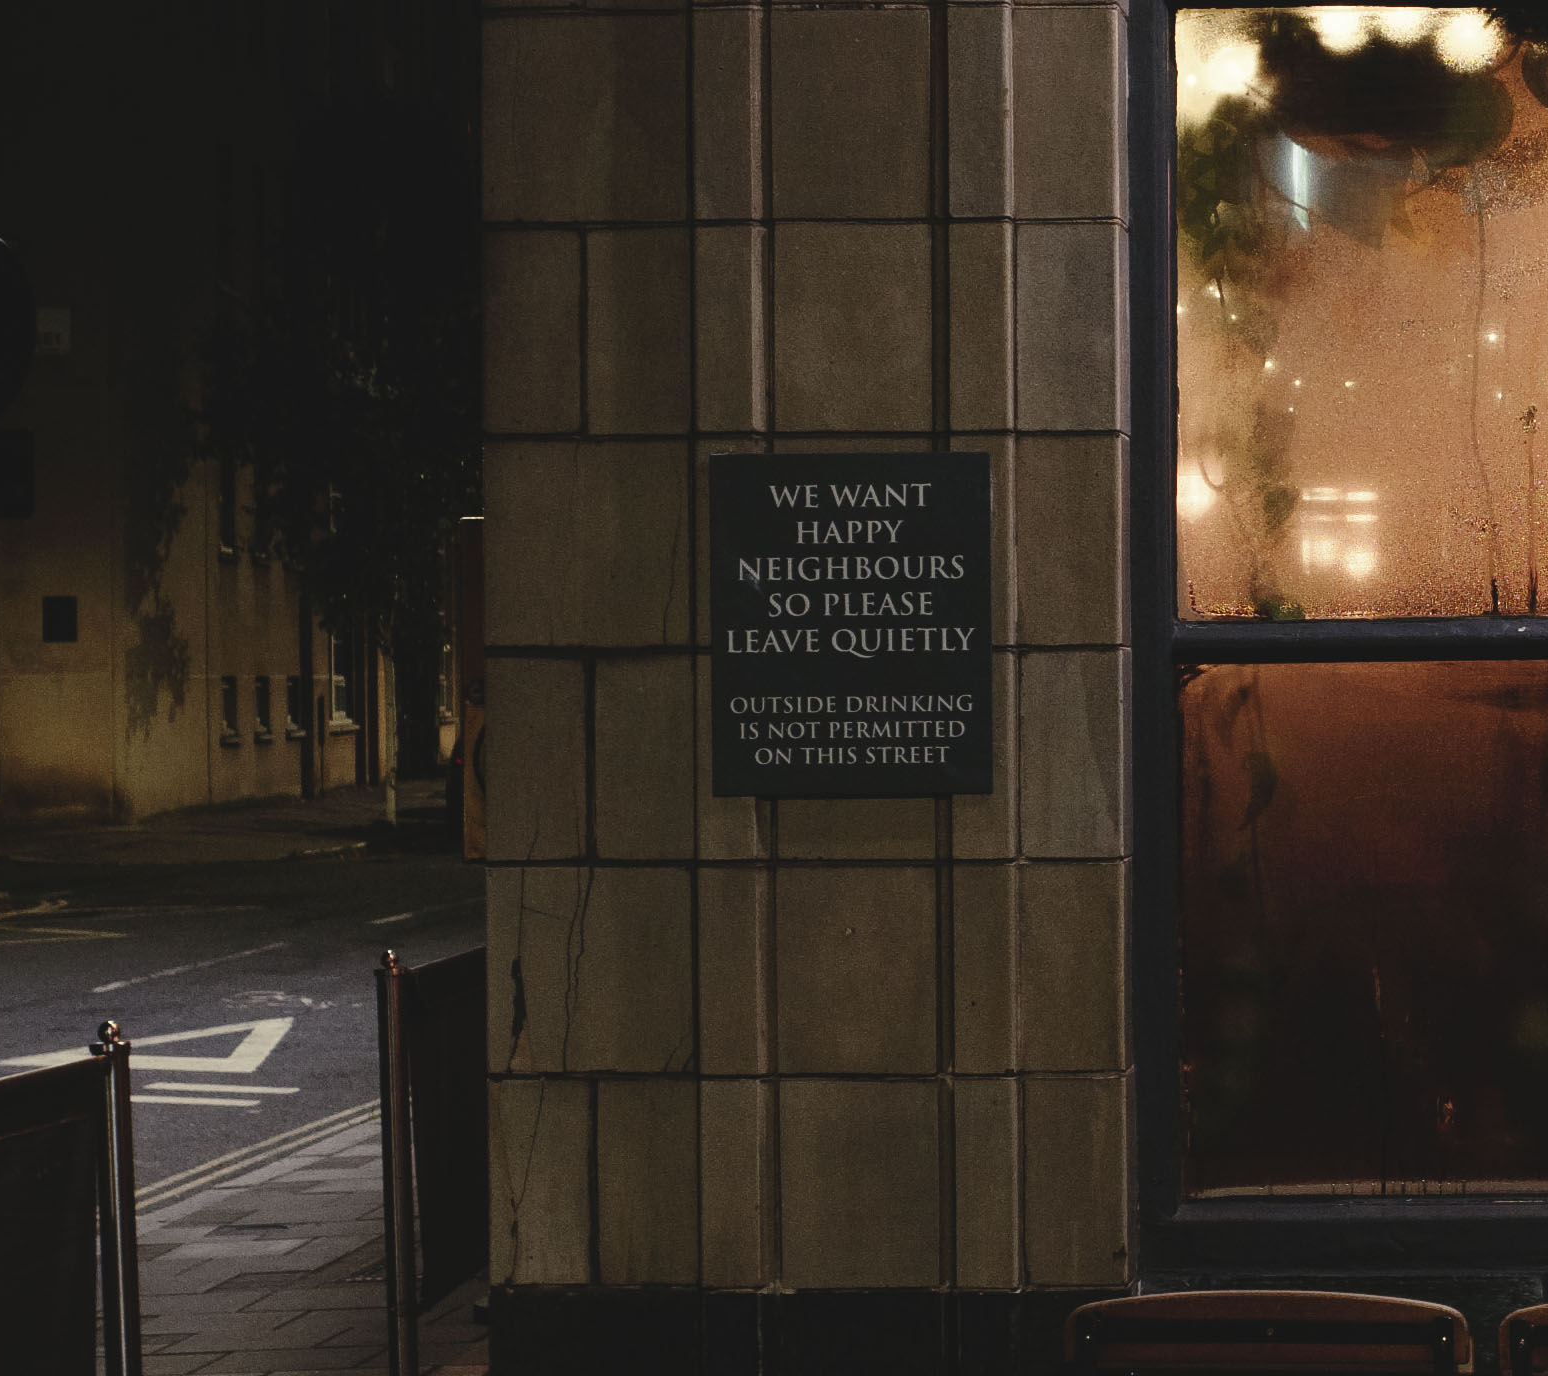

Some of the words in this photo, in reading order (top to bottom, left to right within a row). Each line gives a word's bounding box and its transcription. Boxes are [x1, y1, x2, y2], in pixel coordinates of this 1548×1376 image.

[768, 484, 820, 509] WE
[829, 482, 932, 508] WANT
[796, 519, 904, 544] HAPPY
[738, 554, 965, 583] NEIGHBOURS
[767, 592, 811, 618] SO
[823, 591, 934, 617] PLEASE
[726, 629, 820, 655] LEAVE
[830, 627, 976, 659] QUIETLY
[729, 696, 837, 715] OUTSIDE
[845, 694, 974, 714] DRINKING
[739, 722, 760, 741] IS
[767, 721, 822, 740] NOT
[828, 720, 966, 739] PERMITTED
[753, 747, 792, 766] ON
[799, 746, 857, 765] THIS
[864, 745, 951, 765] STREET
